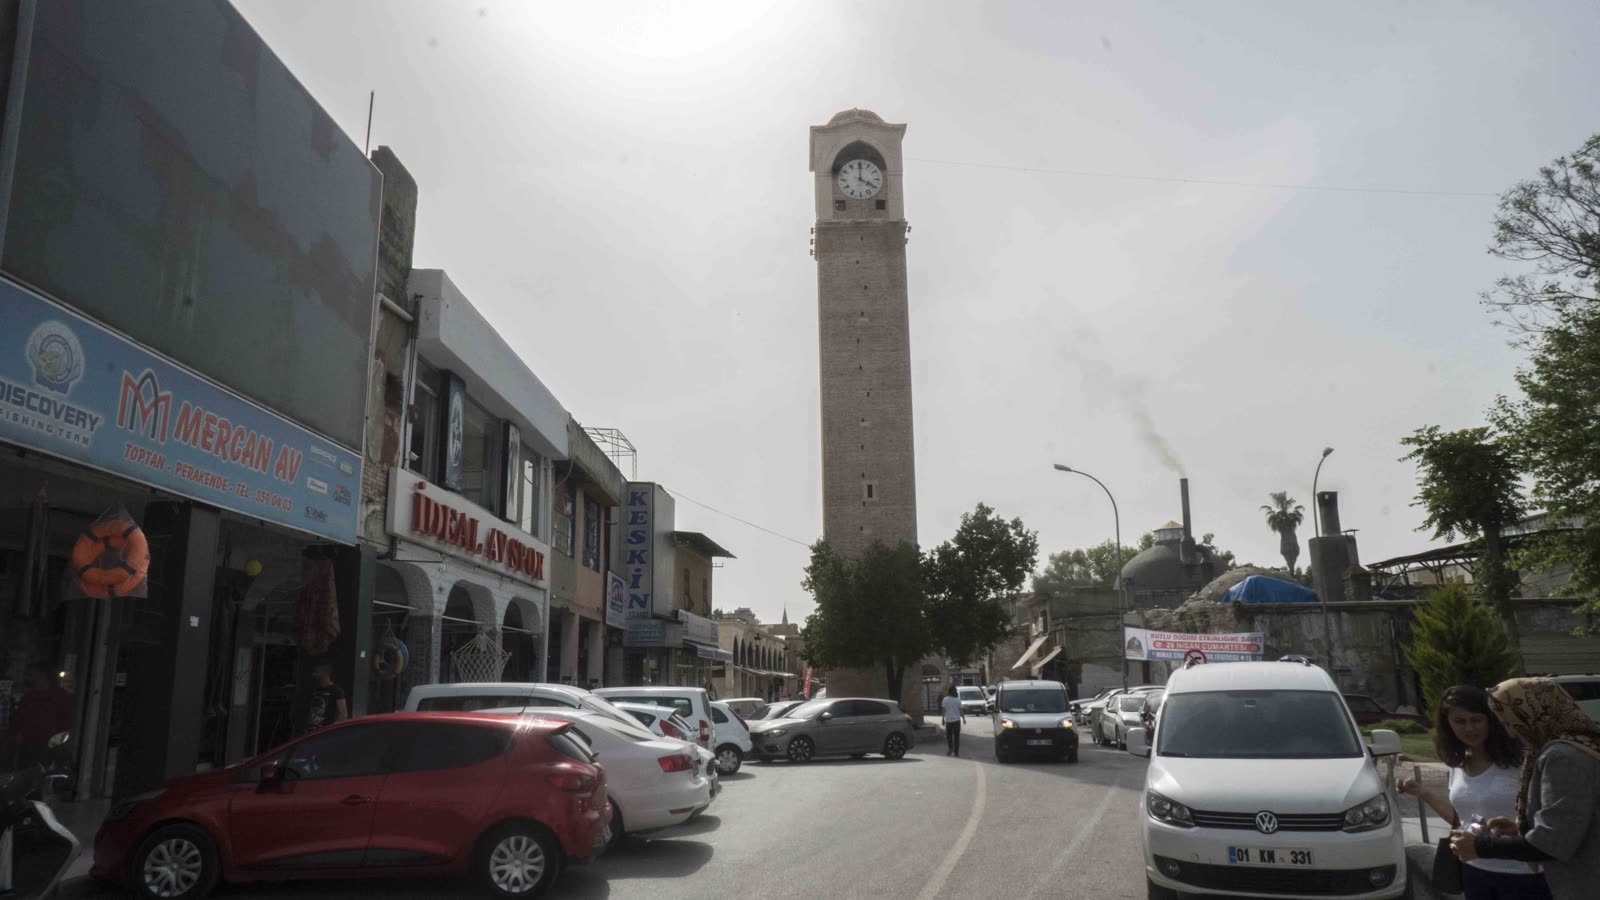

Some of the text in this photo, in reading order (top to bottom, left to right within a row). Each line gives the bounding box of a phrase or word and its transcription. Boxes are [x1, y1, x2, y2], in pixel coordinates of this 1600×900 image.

[174, 402, 302, 482] MERCAN AV
[124, 444, 166, 470] TOPTAN
[175, 462, 228, 492] PERAKENDE
[486, 527, 507, 563] AV
[625, 491, 650, 609] KESKİN
[1237, 848, 1249, 862] 01
[1290, 850, 1312, 865] 331
